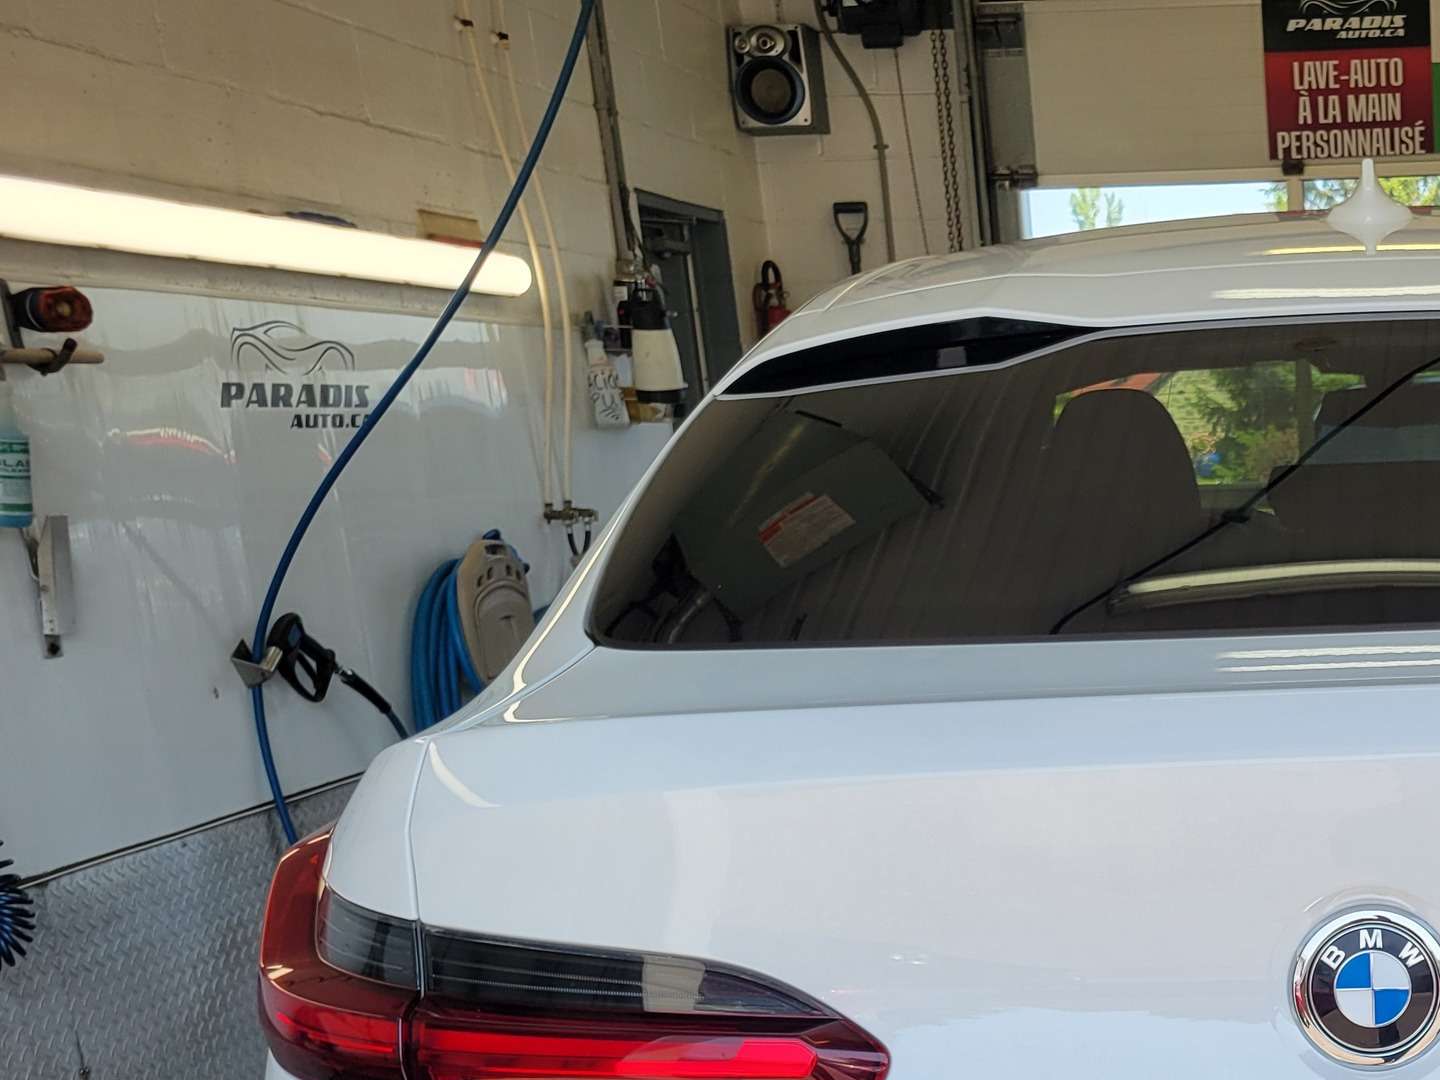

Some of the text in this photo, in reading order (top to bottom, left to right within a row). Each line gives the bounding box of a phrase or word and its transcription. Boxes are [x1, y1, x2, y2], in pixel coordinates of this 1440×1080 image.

[1286, 15, 1405, 32] PARADIS
[1336, 28, 1405, 39] AUTO.CA
[1292, 58, 1404, 91] LAVE-AUTO
[1298, 90, 1401, 124] À LA MAIN
[1276, 120, 1426, 159] PERSONNALISÉ
[220, 382, 370, 408] PARADIS
[1320, 928, 1424, 970] BMW
